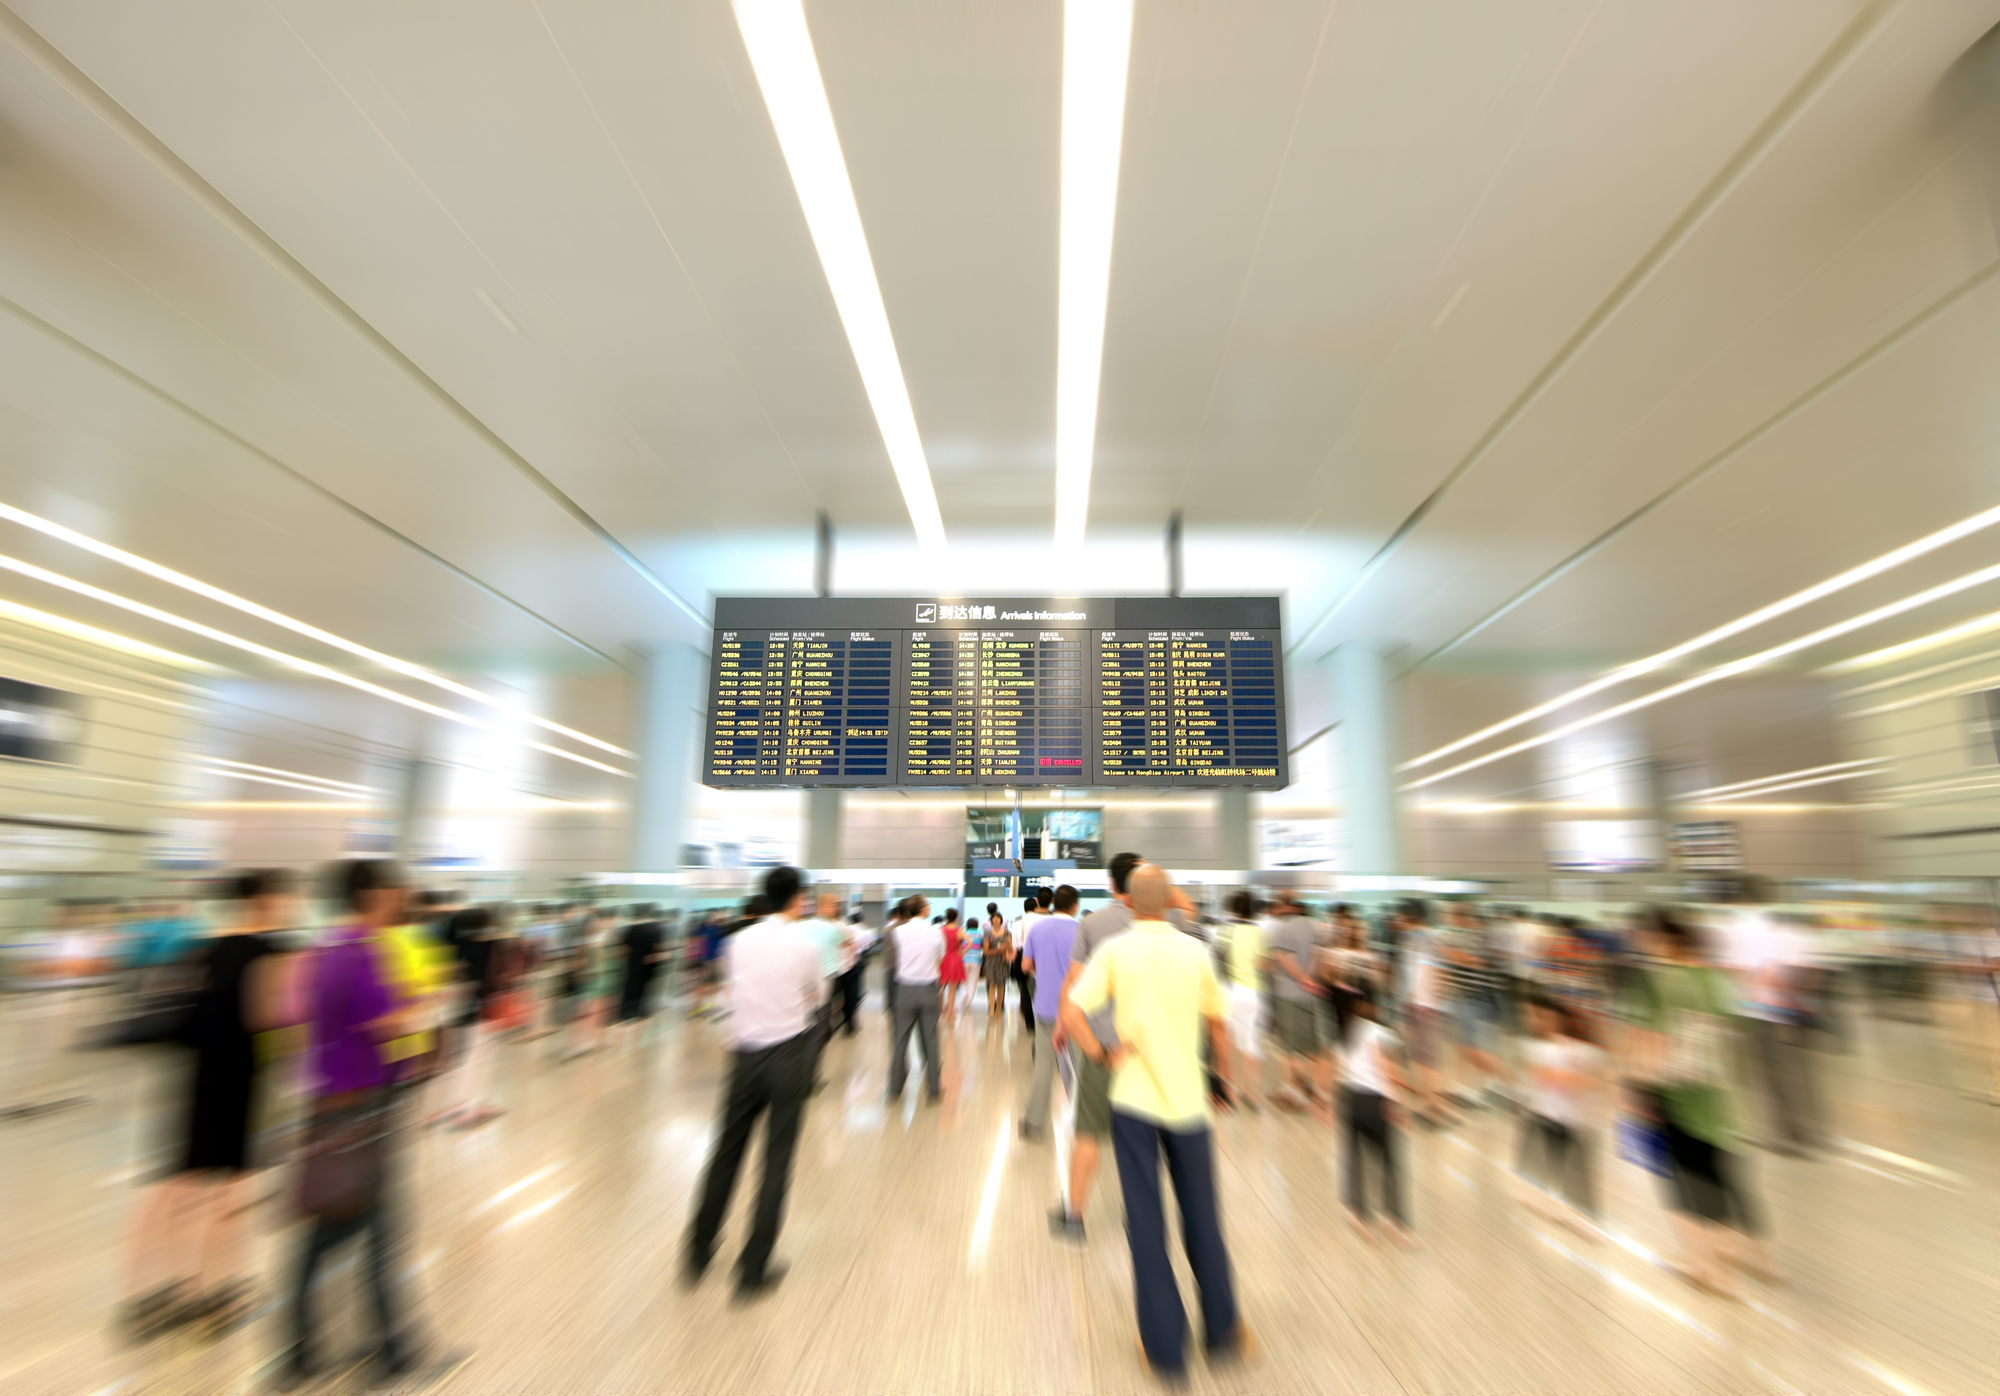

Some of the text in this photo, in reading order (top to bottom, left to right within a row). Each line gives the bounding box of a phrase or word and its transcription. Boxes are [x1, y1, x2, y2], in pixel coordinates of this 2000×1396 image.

[939, 605, 1086, 621] 到达信息 Arrivals Information
